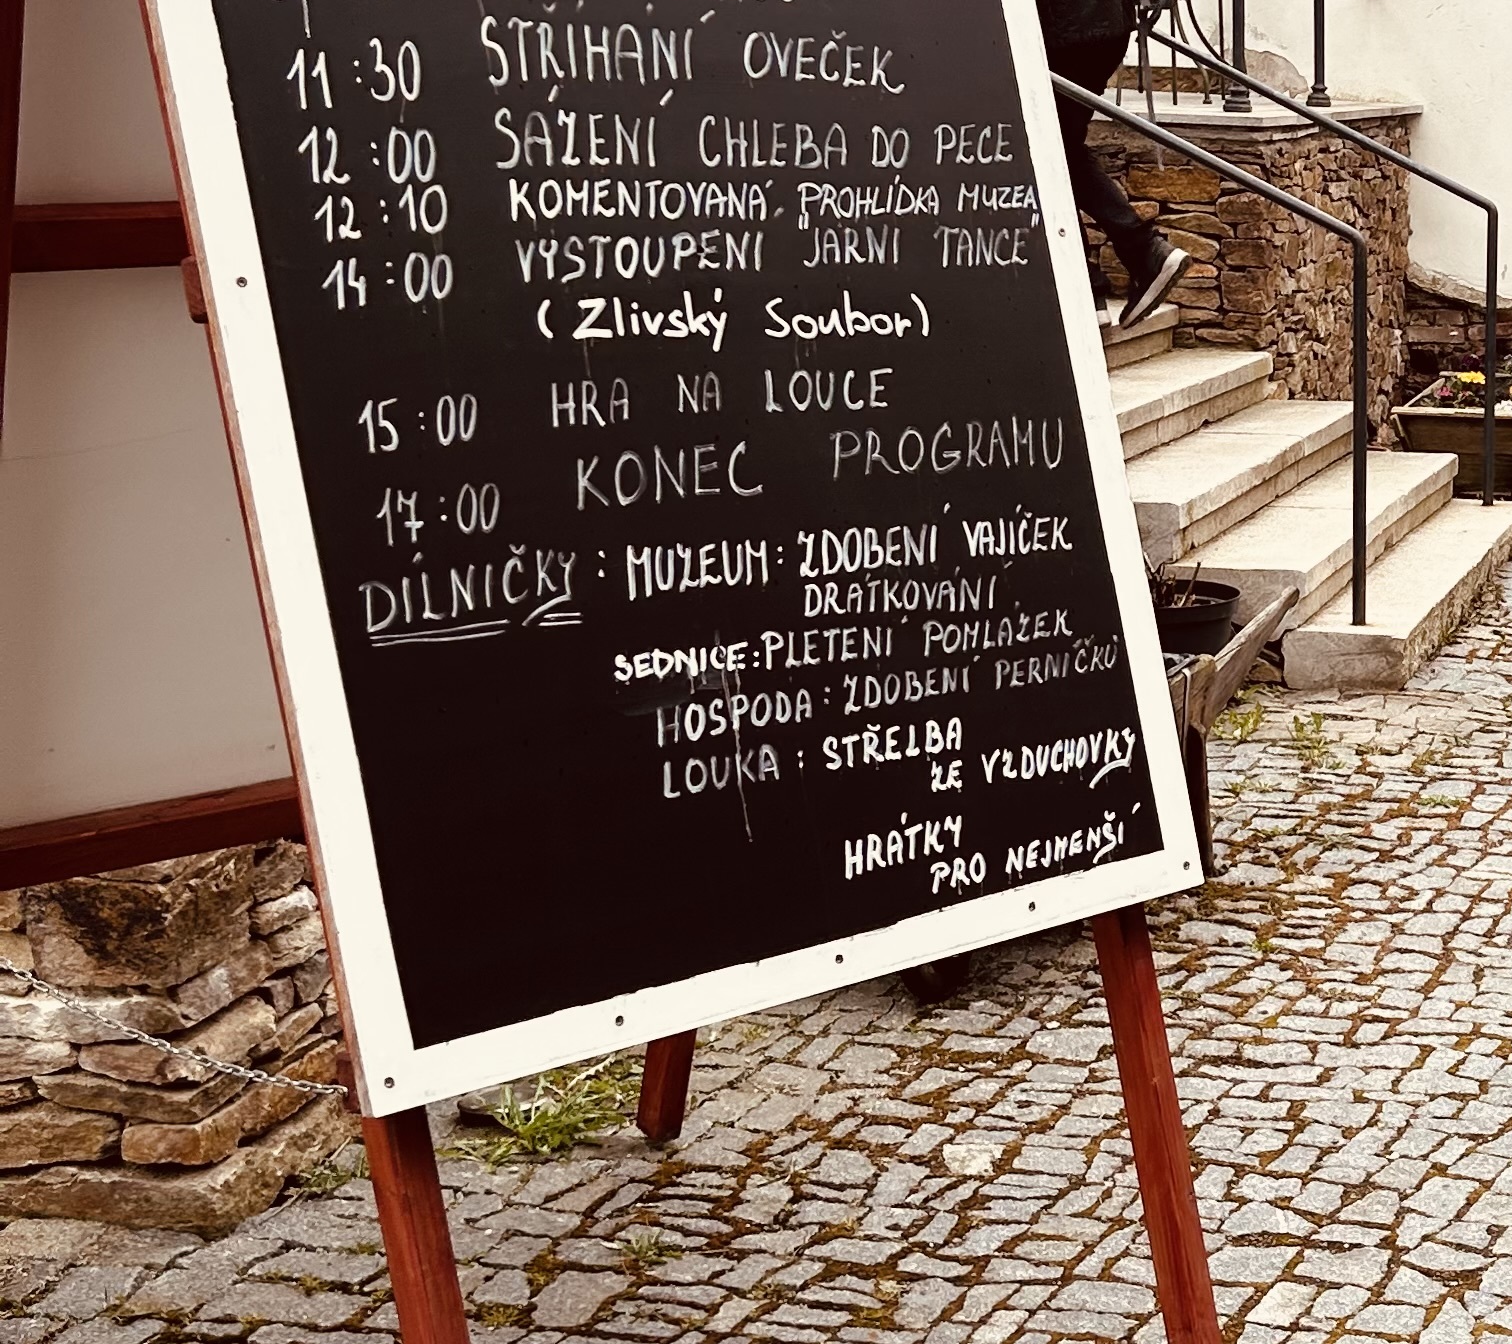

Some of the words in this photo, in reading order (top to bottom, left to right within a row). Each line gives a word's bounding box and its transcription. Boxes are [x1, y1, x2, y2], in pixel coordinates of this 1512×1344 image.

[286, 38, 422, 110] 11:30
[480, 0, 717, 88] STŘÍHÁNÍ
[743, 30, 906, 94] OVEČEK
[299, 126, 437, 184] 12:00
[494, 84, 674, 170] SÁZENÍ
[699, 114, 848, 170] CHLEBA
[871, 124, 910, 169] DO
[933, 123, 1013, 165] PECE
[314, 185, 449, 244] 12:10
[508, 178, 774, 222] KOMENTOVANÁ
[796, 174, 941, 219] PROHLÍDKA
[957, 182, 1039, 212] MUZEA
[321, 252, 454, 311] 14:00
[764, 290, 930, 339] Soubor)
[358, 394, 478, 454] 15:00
[551, 377, 630, 428] HRA
[676, 372, 721, 414] NA
[764, 367, 893, 413] LOUCE
[376, 482, 500, 547] 17:00
[576, 441, 763, 512] KONEC
[829, 416, 1064, 481] PROGRAMU
[797, 502, 951, 578] ZDOBENÍ
[961, 504, 1073, 557] VAJÍČEK
[804, 560, 1014, 618] DRÁTKOVÁNÍ
[613, 641, 761, 682] SEDNICE:
[762, 614, 909, 670] PLETENÍ
[922, 600, 1074, 657] POMLÁZEK
[843, 655, 981, 716] ZDOBENÍ
[822, 716, 963, 772] STŘELBA
[931, 759, 963, 793] ZE
[981, 727, 1136, 790] VZDUCHOVKY
[844, 812, 963, 881] HRÁTKY
[930, 852, 987, 894] PRO
[1005, 802, 1142, 875] NEJMENŠÍ
